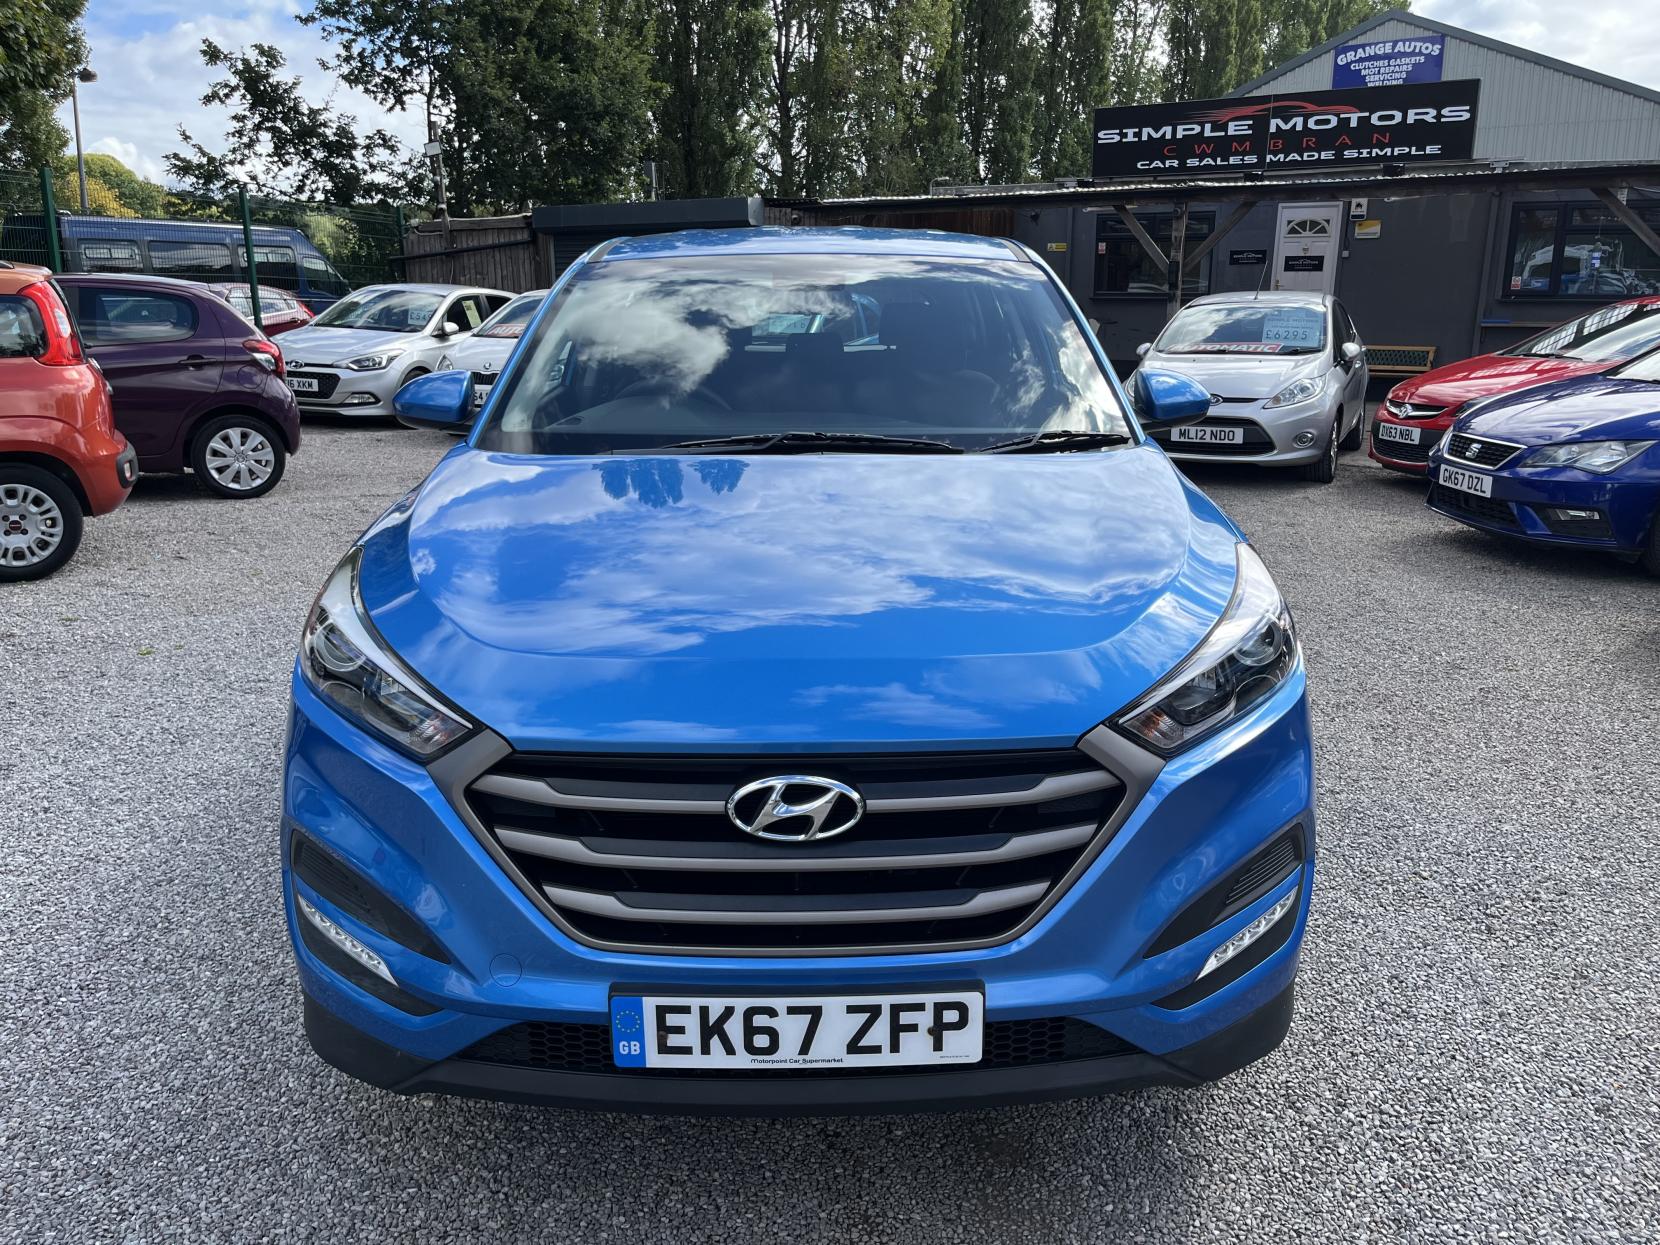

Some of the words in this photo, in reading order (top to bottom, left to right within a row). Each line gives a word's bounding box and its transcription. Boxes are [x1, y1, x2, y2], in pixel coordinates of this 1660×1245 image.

[1337, 43, 1393, 65] GRANGE
[1394, 41, 1441, 55] AUTOS
[1350, 59, 1389, 70] CLUTCHES
[1390, 56, 1425, 65] GASKETS
[1361, 67, 1380, 76] MOT
[1380, 64, 1413, 74] REPAIRS
[1365, 71, 1407, 82] SERVICING
[1097, 120, 1254, 144] SIMPLE
[1269, 105, 1471, 132] MOTORS
[1136, 159, 1179, 169] CAR
[1186, 155, 1258, 167] SALES
[1266, 151, 1336, 163] MADE
[1343, 145, 1442, 158] SIMPLE
[1265, 329, 1308, 340] £6295
[1168, 343, 1276, 352] AUTOMATIC
[297, 380, 314, 389] XKM
[1178, 428, 1207, 440] ML12
[1209, 429, 1235, 441] NDO
[1398, 428, 1415, 441] NBL
[1442, 468, 1466, 487] GK67
[1467, 474, 1487, 494] DZL
[655, 1004, 823, 1056] EK67
[845, 1001, 970, 1055] ZFP
[619, 1041, 641, 1055] GB
[801, 1057, 844, 1065] Supermarket
